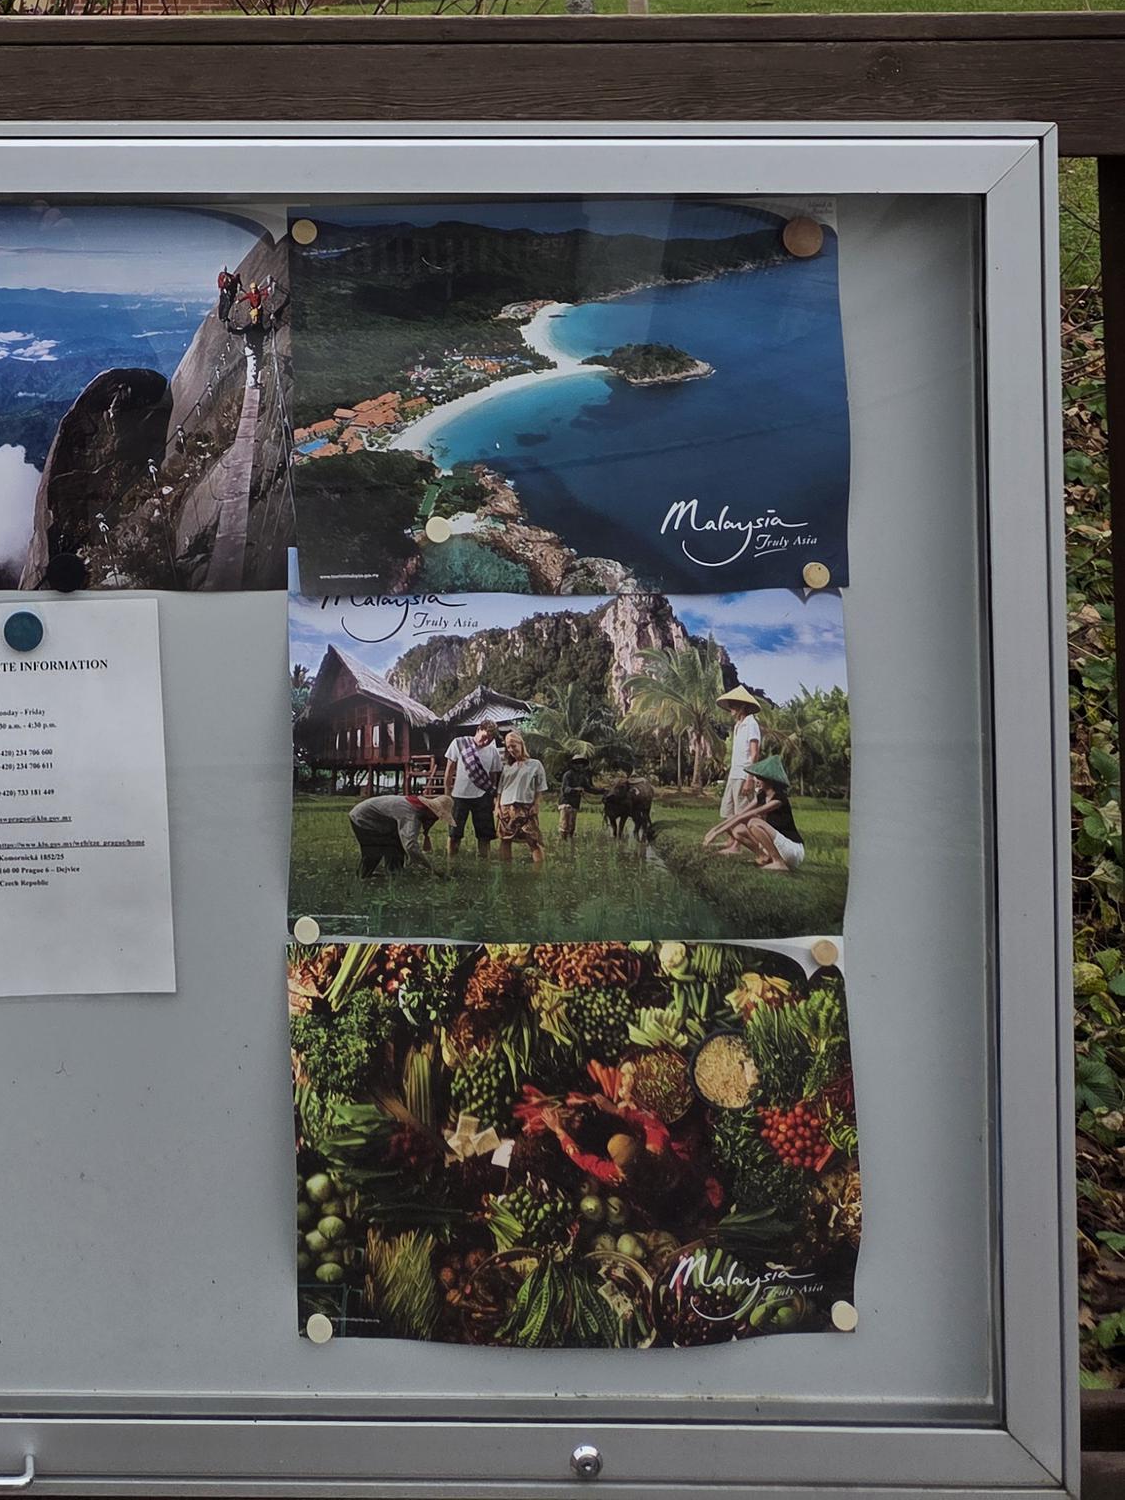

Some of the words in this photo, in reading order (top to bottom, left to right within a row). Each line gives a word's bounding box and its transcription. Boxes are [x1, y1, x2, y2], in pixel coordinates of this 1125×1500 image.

[660, 498, 809, 567] Malaysia
[754, 534, 790, 550] Truly
[793, 534, 818, 546] Asia
[413, 612, 449, 629] Truly
[453, 616, 479, 628] Asia
[20, 659, 109, 672] INFORMATION
[24, 708, 46, 716] Friday
[42, 722, 57, 730] p.m.
[16, 749, 28, 757] 234
[41, 762, 53, 770] 611
[21, 866, 44, 875] Prague
[56, 865, 80, 874] Dejvice
[0, 880, 19, 888] Czech
[20, 879, 49, 888] Republic
[669, 1255, 815, 1321] Malaysia
[799, 1283, 824, 1295] Asia
